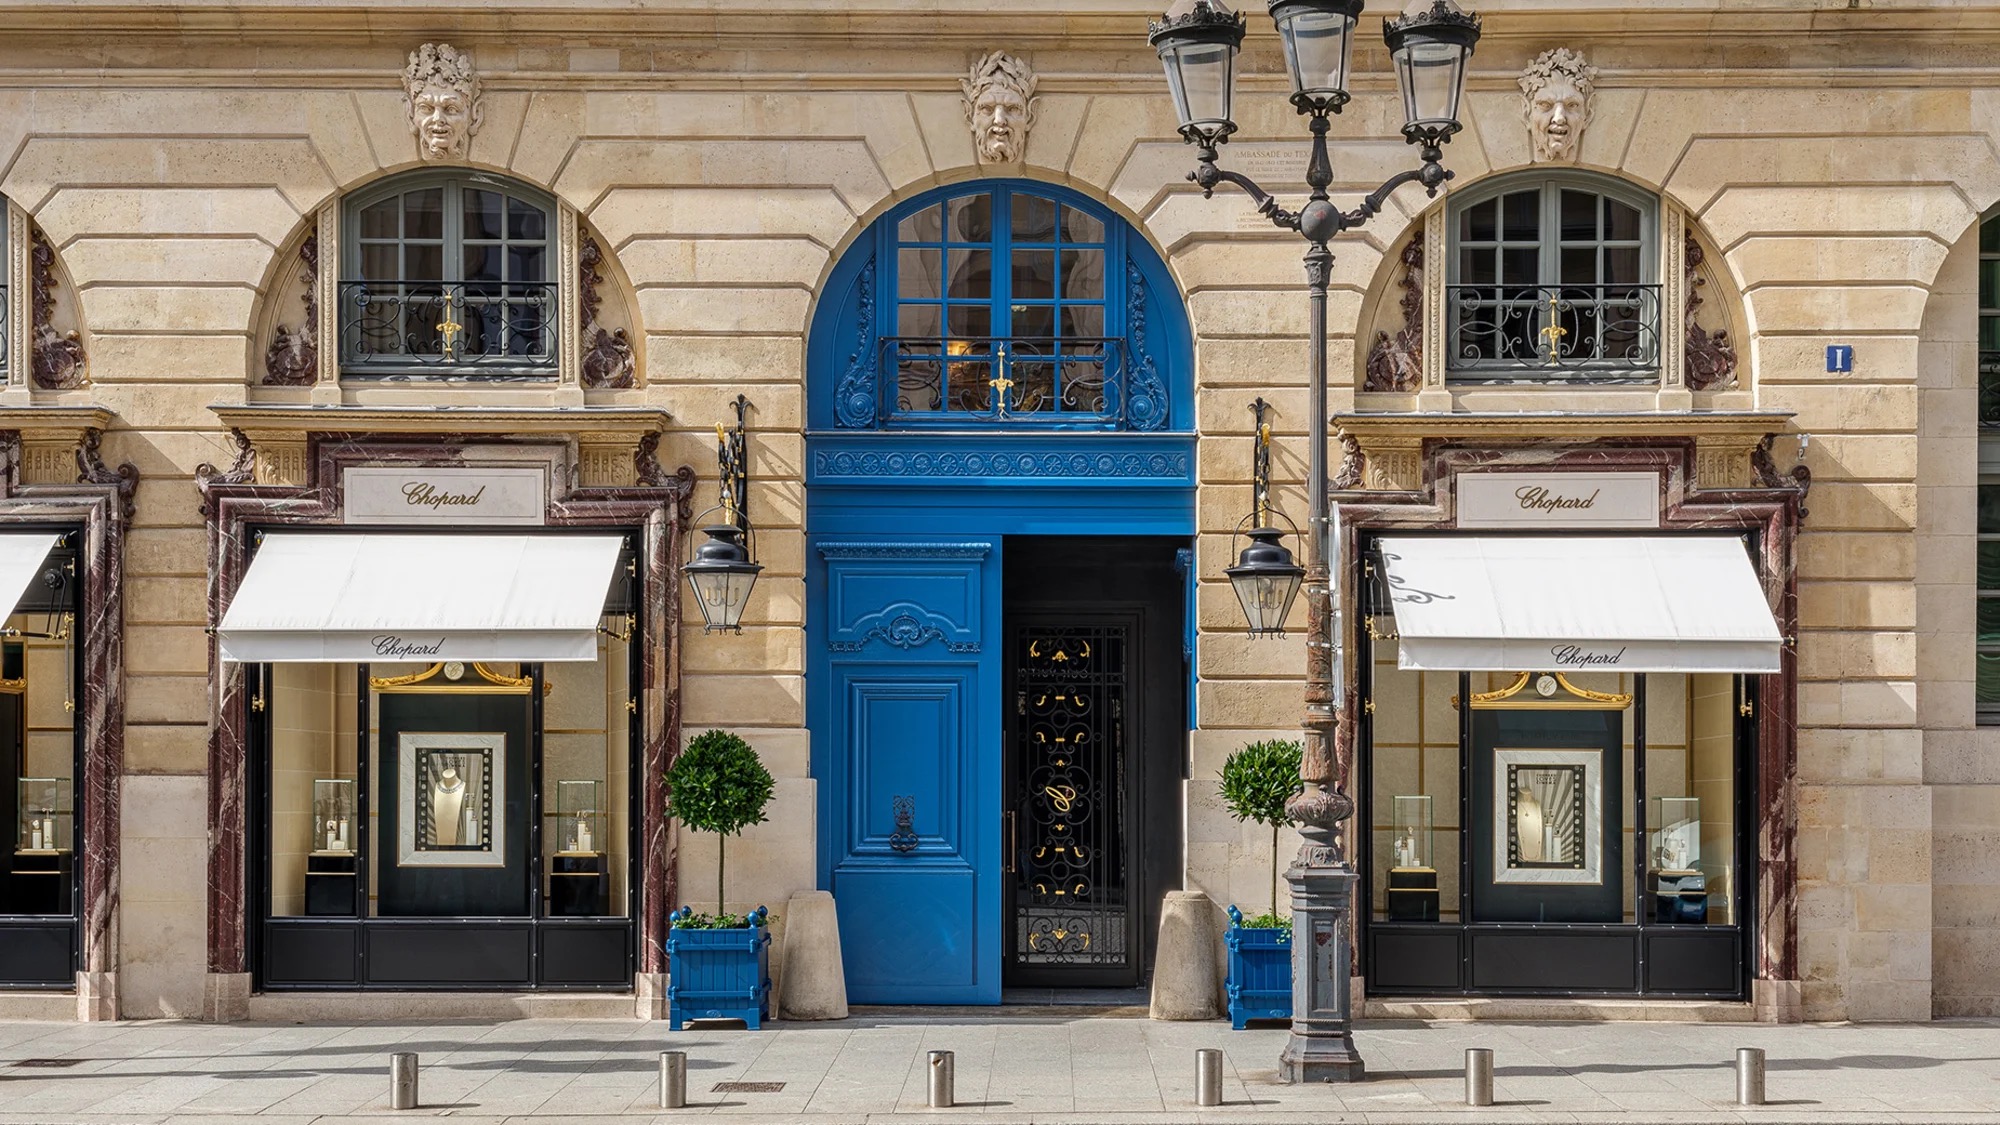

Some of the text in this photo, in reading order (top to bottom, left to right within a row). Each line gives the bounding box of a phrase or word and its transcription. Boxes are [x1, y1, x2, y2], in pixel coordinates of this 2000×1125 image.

[401, 481, 486, 511] Chopard
[1514, 485, 1600, 514] Chopard
[371, 634, 446, 659] Chopard
[1550, 644, 1627, 669] Chopard
